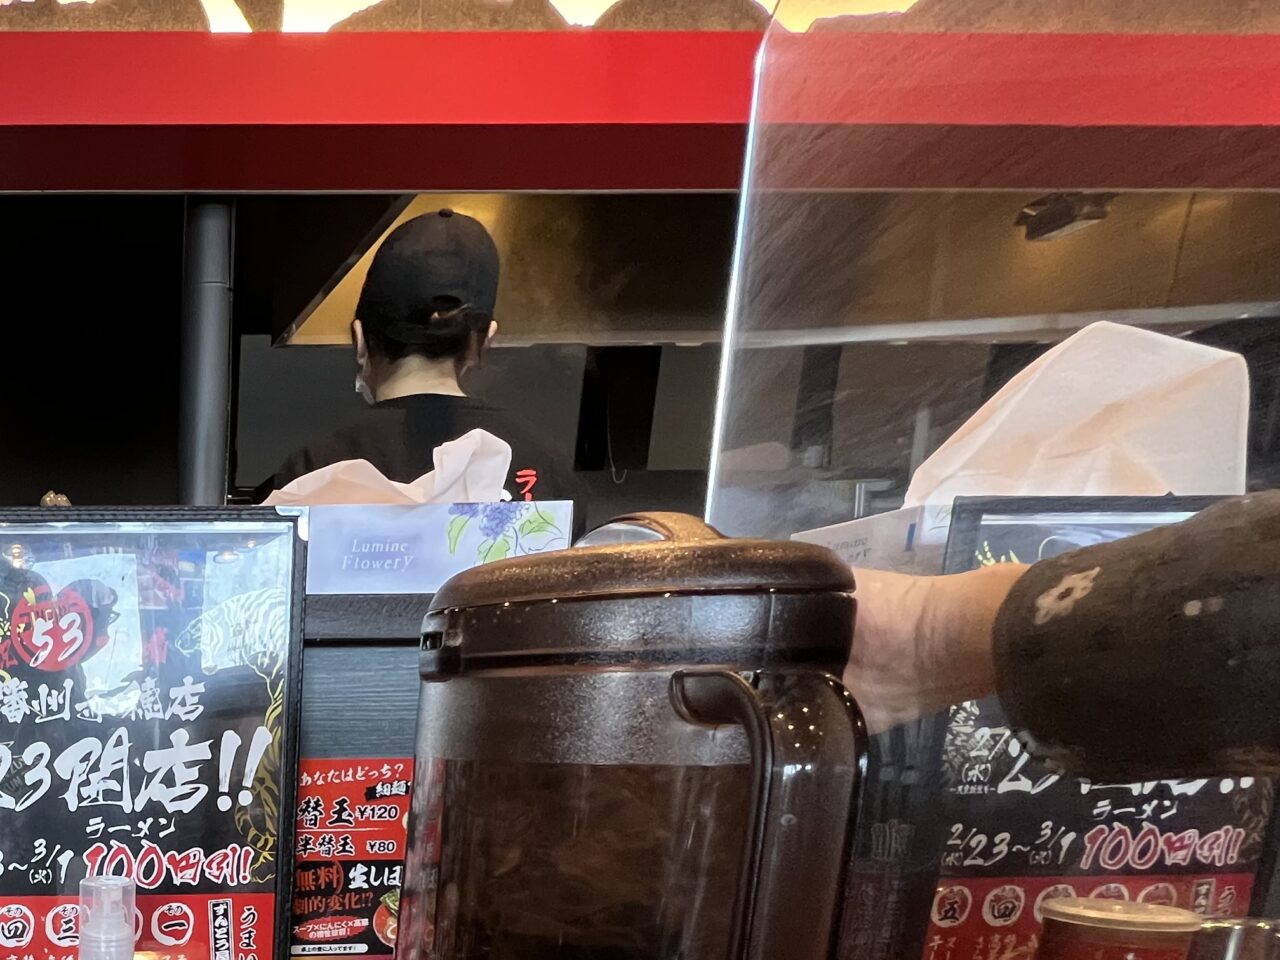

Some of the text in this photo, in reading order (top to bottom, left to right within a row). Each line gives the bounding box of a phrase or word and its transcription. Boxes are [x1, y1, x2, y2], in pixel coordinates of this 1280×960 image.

[351, 539, 409, 553] Lumine
[341, 554, 415, 570] Flowery
[29, 611, 84, 668] 53
[300, 763, 404, 786] あなたはどっち?
[375, 780, 412, 797] 細麺
[297, 796, 399, 828] 替玉 ¥120
[1093, 800, 1178, 820] ラーメン
[84, 816, 176, 839] ラーメン
[297, 834, 397, 857] 半替玉 ¥80
